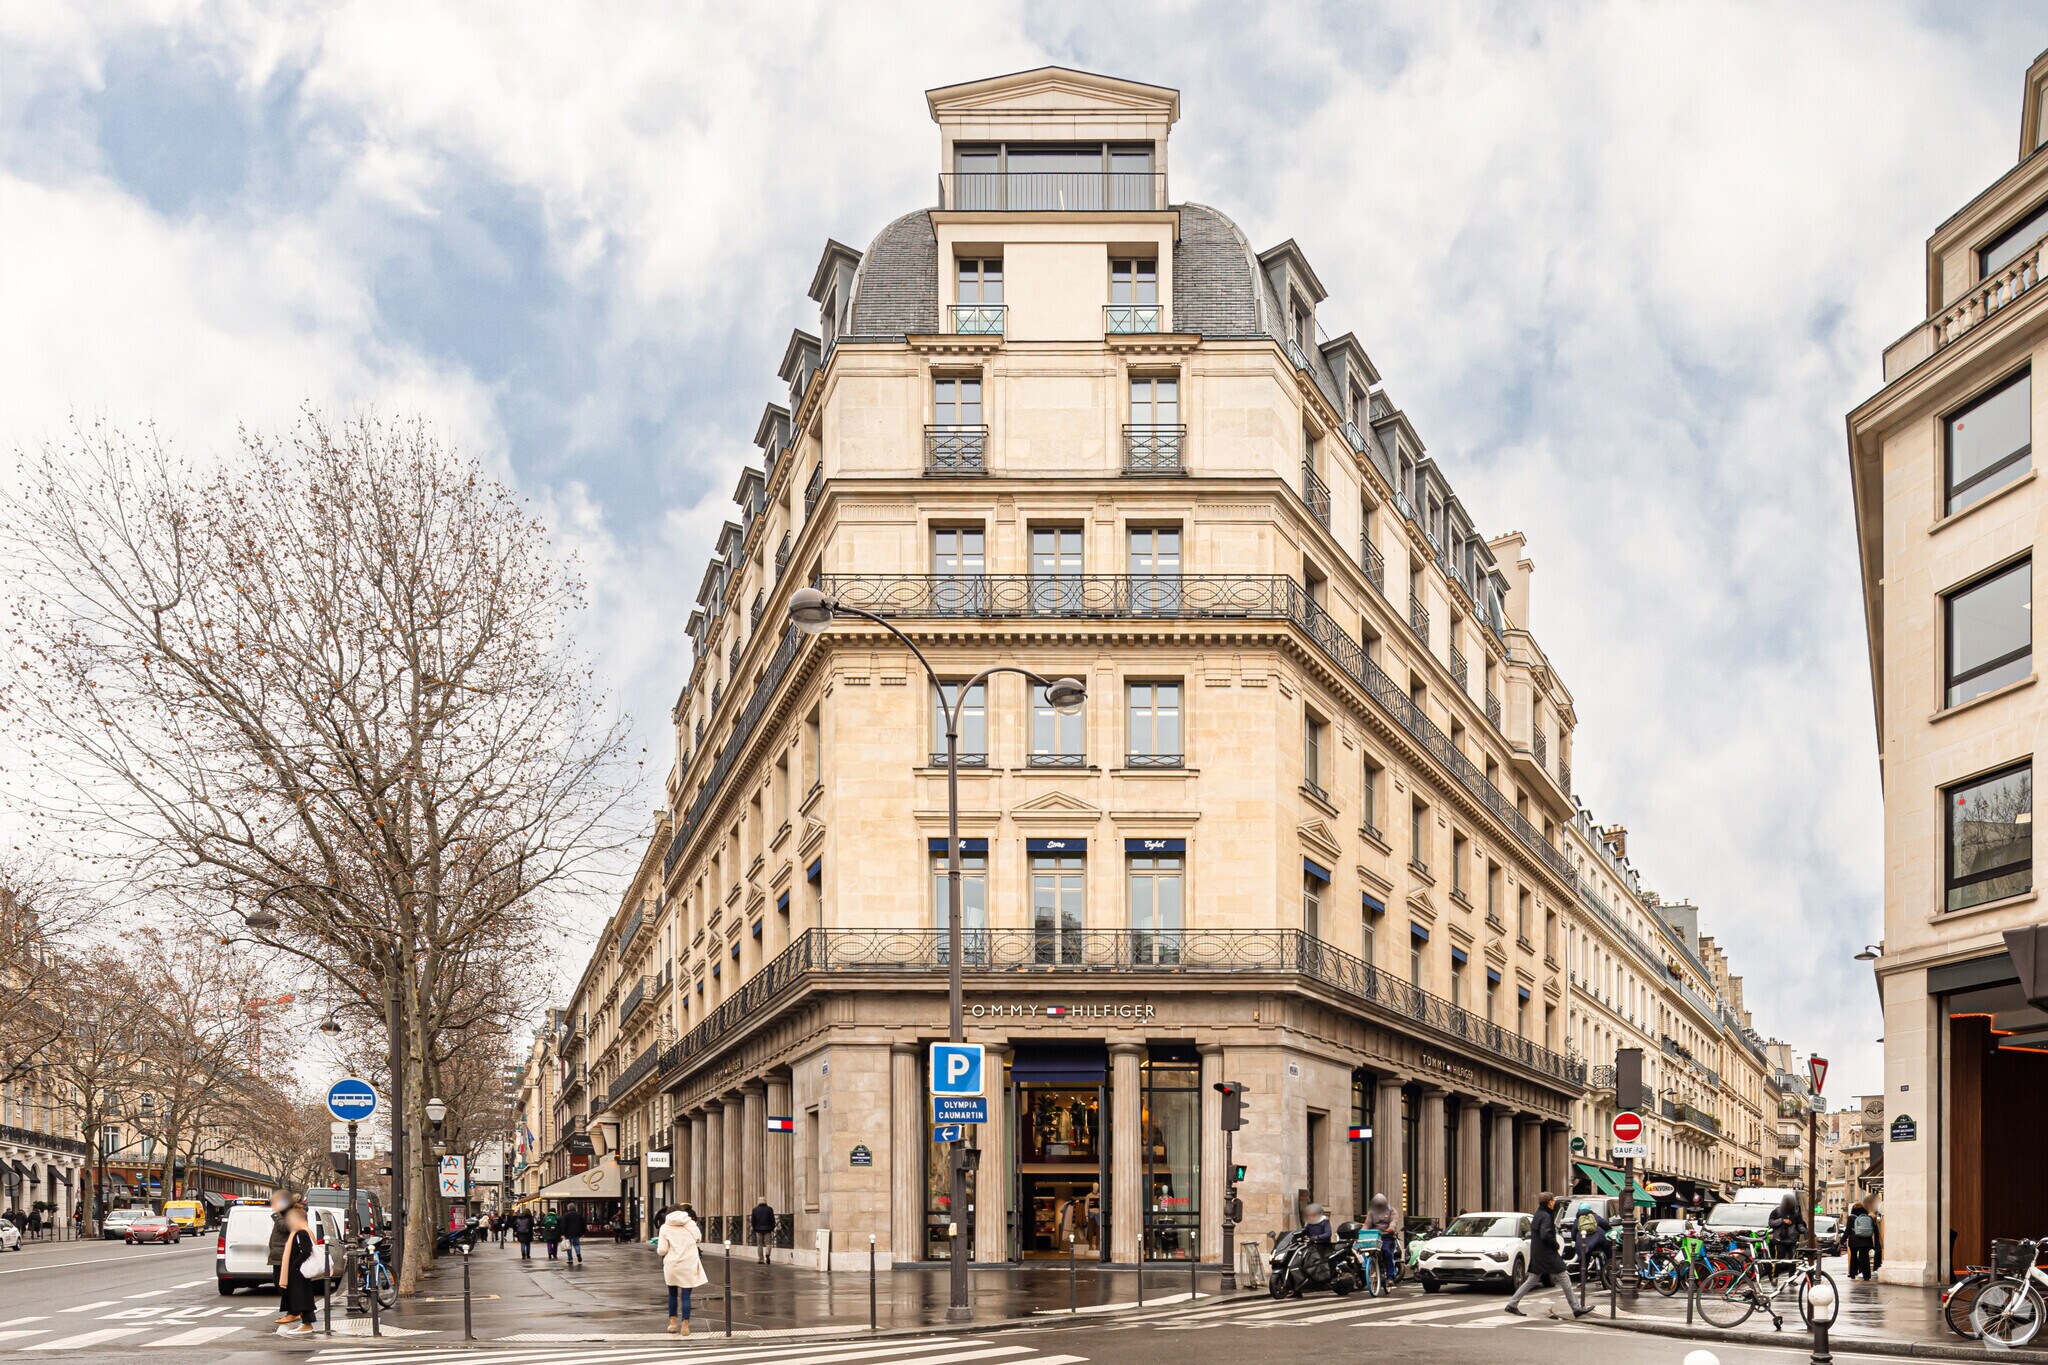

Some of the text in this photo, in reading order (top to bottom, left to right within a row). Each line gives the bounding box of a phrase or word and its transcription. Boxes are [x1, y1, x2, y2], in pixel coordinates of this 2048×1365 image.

[1072, 1004, 1155, 1017] HILFIGER
[1422, 1054, 1446, 1071] TOMMY
[947, 1053, 970, 1085] P
[944, 1101, 977, 1109] OLYMPIA
[938, 1111, 983, 1119] CAUMARTIN
[94, 1307, 281, 1319] BUS
